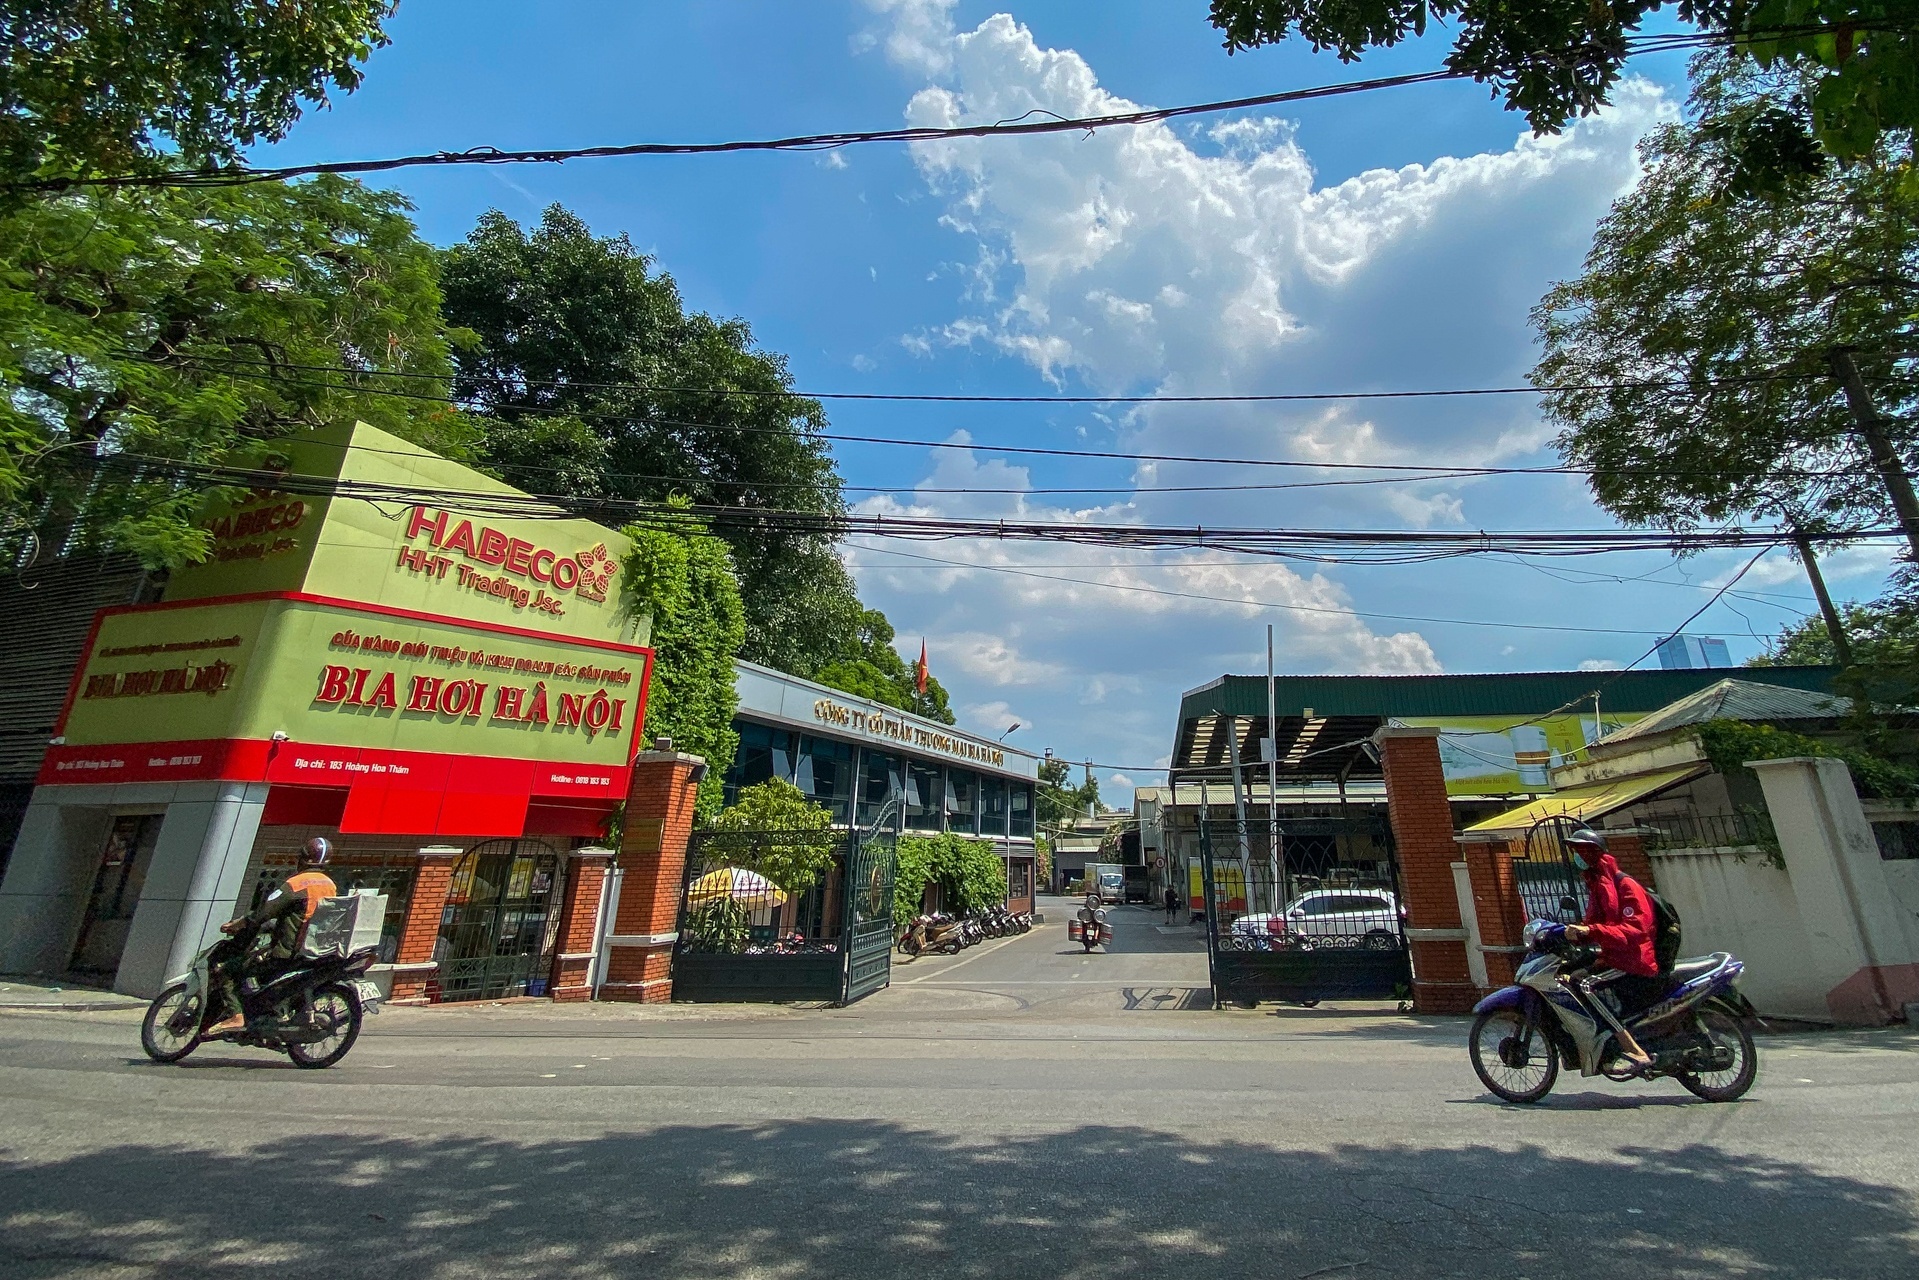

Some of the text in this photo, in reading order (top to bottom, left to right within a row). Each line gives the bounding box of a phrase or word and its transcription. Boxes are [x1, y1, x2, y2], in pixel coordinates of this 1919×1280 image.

[407, 506, 579, 590] HABECO
[398, 546, 454, 579] HHT
[458, 563, 531, 608] Trading
[532, 589, 566, 615] Jsc.
[361, 635, 401, 654] HÀNG
[431, 646, 468, 664] THIỆU
[486, 654, 515, 669] KINH
[515, 658, 555, 674] DOANH
[555, 662, 578, 676] CÁC
[315, 665, 626, 736] BIA HƠI HÀ NỘI
[814, 699, 850, 726] CÔNG
[852, 710, 866, 729] TY
[329, 760, 343, 770] 183
[344, 762, 369, 774] Hoàng
[371, 763, 387, 773] Hoa
[388, 764, 410, 775] Thám
[551, 774, 573, 784] Hotline:
